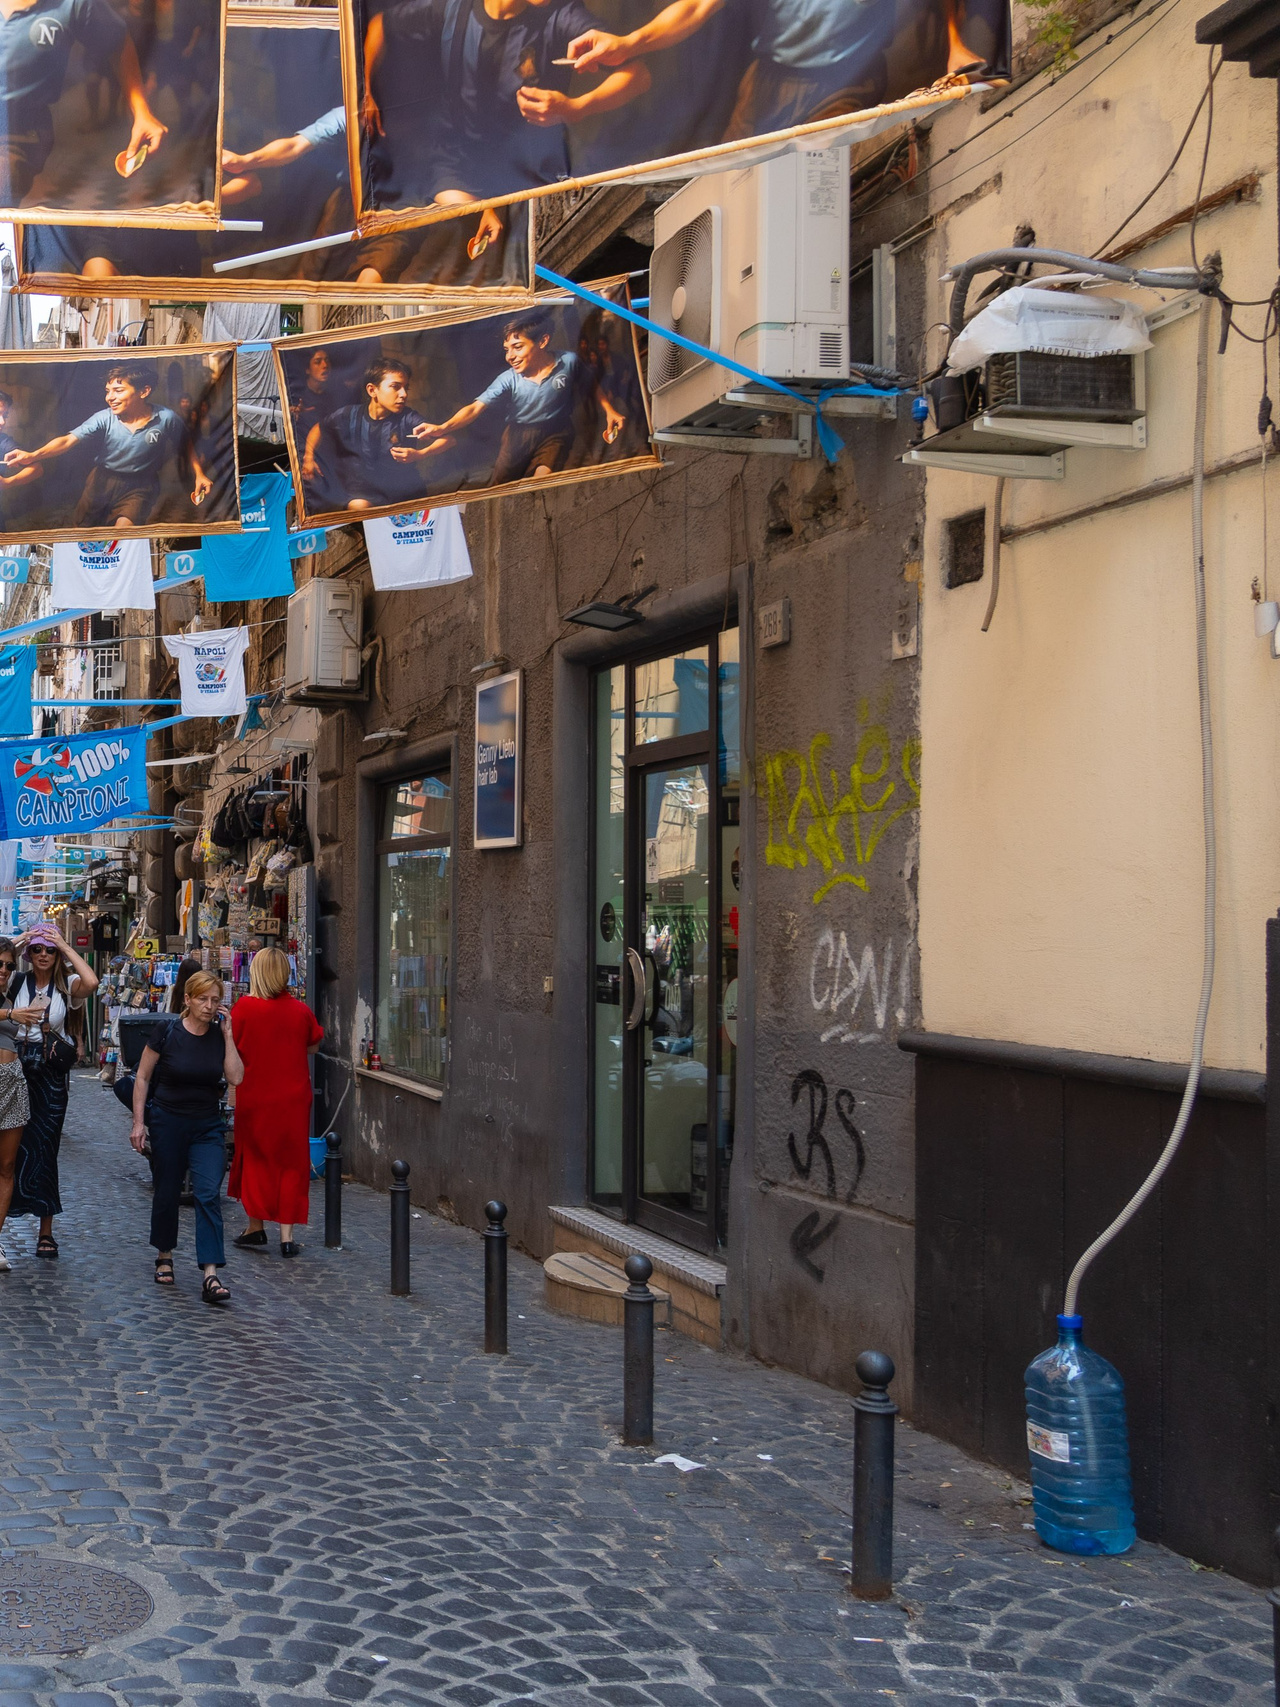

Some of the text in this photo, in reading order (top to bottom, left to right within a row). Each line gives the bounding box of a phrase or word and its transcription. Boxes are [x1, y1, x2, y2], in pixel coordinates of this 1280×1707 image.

[392, 528, 434, 539] CAMPIONI
[396, 537, 424, 545] D'ITALIA
[79, 555, 121, 564] CAMPIONI
[763, 610, 778, 640] 268
[194, 647, 227, 656] NAPOLI
[478, 738, 515, 766] Genny Lieto
[70, 738, 131, 784] 100%
[478, 768, 489, 787] hair
[16, 776, 131, 828] CAMPIONI
[145, 941, 154, 957] 2
